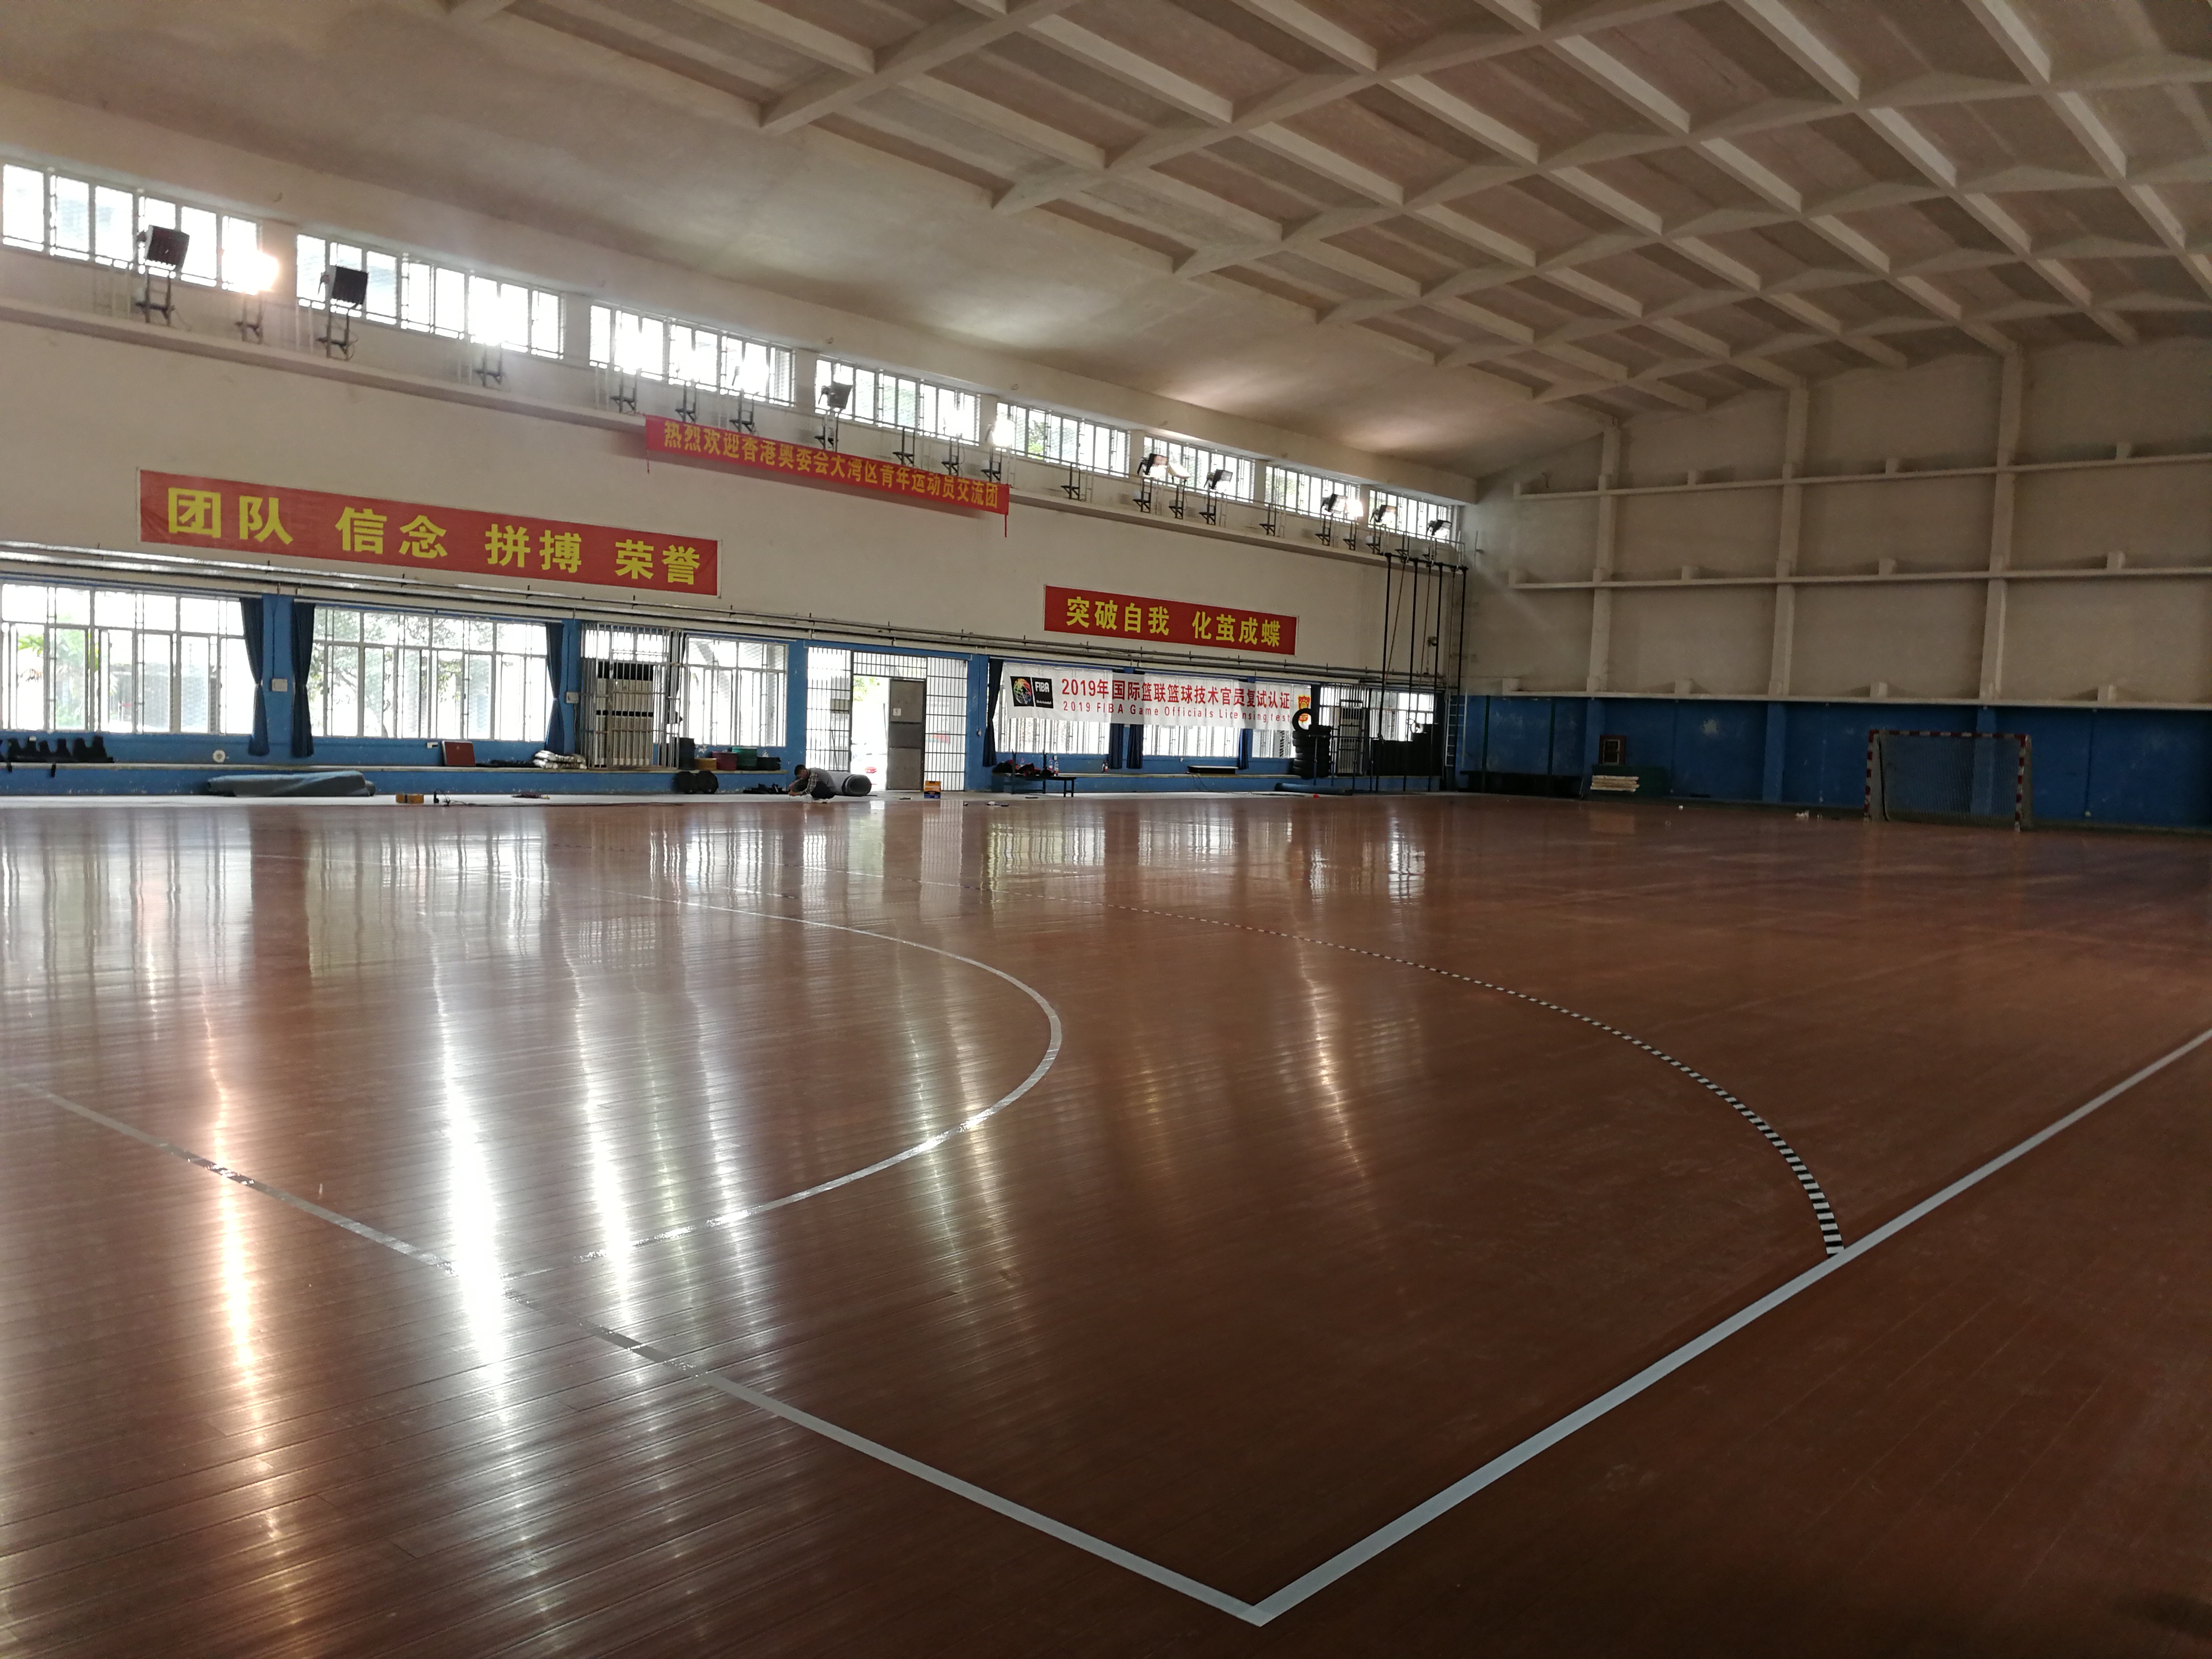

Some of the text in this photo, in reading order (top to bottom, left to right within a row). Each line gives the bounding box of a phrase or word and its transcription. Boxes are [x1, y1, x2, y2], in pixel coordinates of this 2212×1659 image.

[664, 421, 998, 508] 热烈欢迎香港奥委会大湾区青年运动员交流团
[168, 487, 700, 585] 团队 信念 拼搏 荣誉
[1066, 596, 1280, 647] 突破自我 化茧成蝶
[1035, 681, 1050, 692] FIBA
[1061, 678, 1290, 710] 2019年国际篮联篮球技术官员复试认证
[1063, 701, 1091, 712] 2019
[1097, 702, 1124, 714] FIBA
[1129, 704, 1158, 716] Game
[1164, 706, 1214, 718] Officials
[1219, 709, 1267, 722] Licensing
[1270, 712, 1291, 722] test
